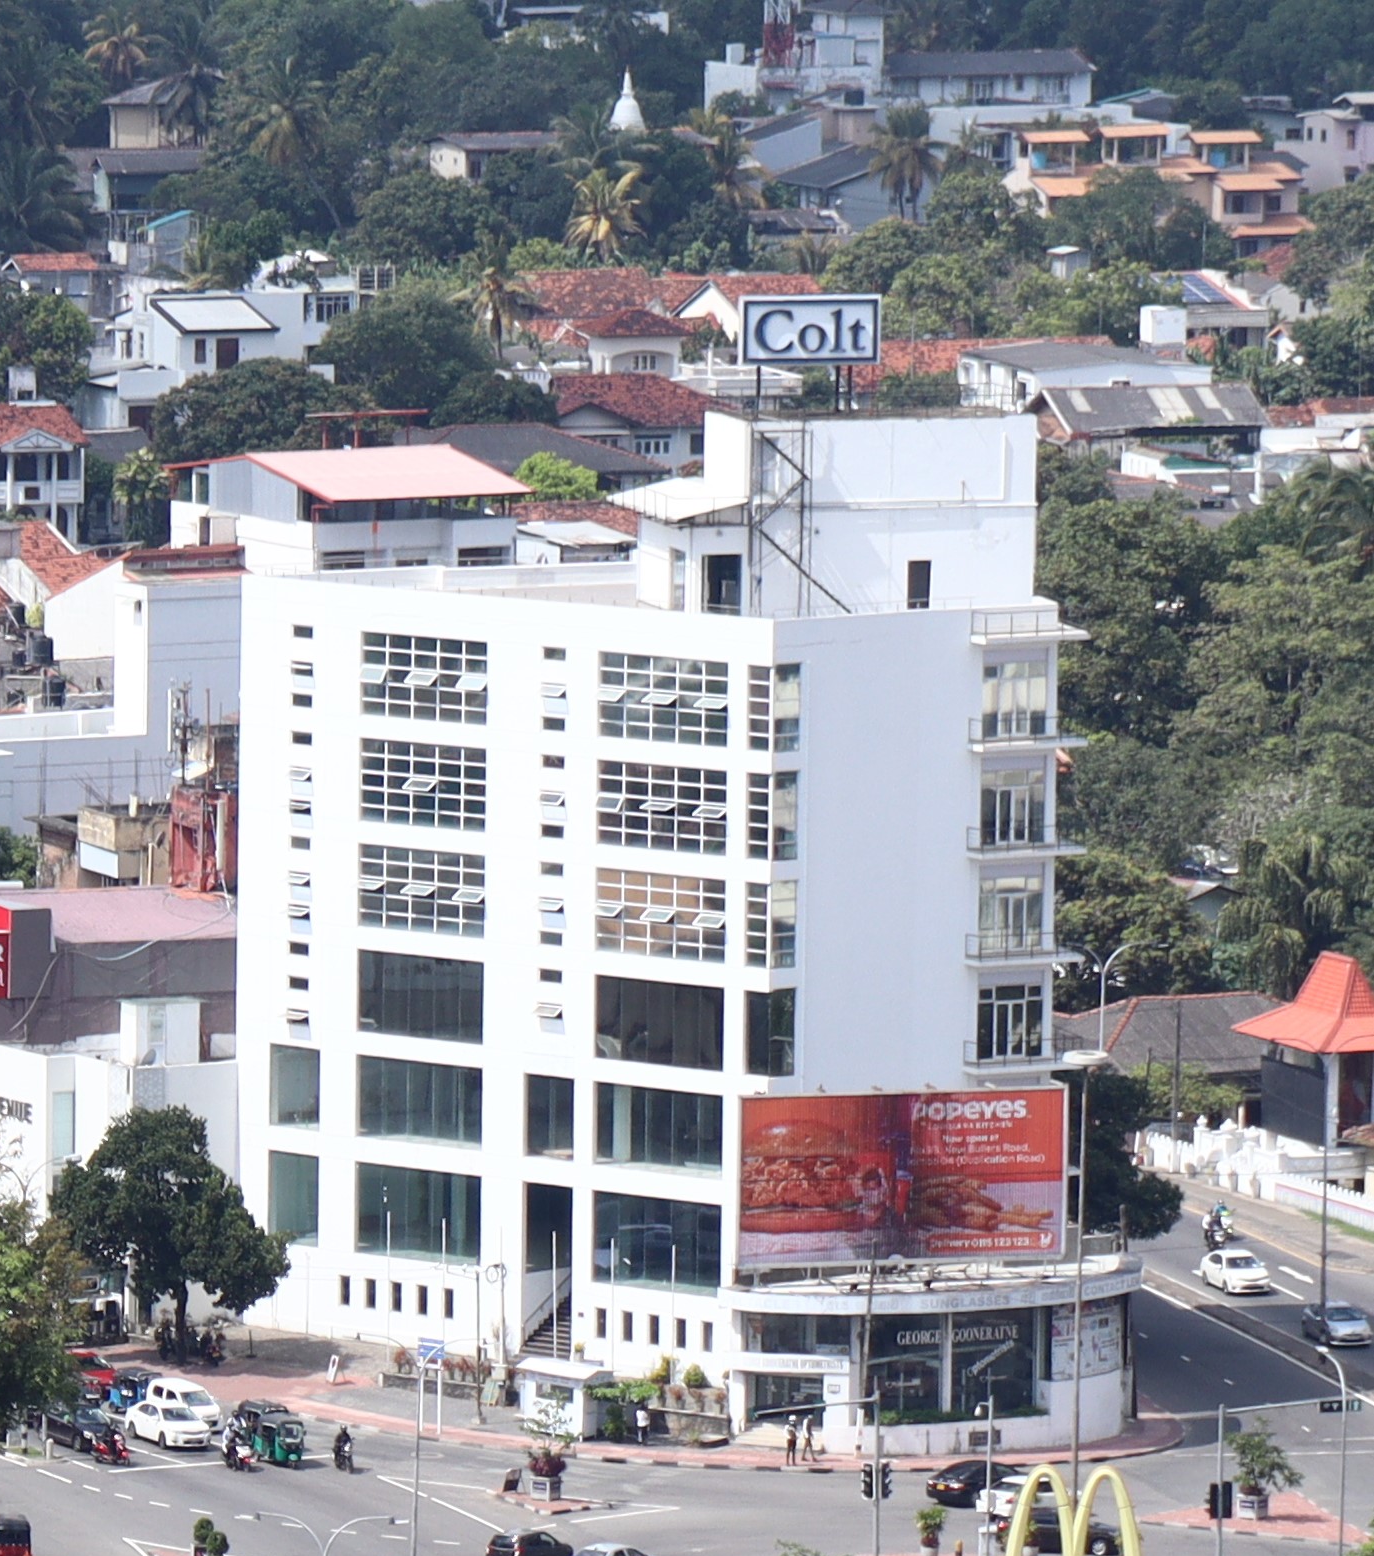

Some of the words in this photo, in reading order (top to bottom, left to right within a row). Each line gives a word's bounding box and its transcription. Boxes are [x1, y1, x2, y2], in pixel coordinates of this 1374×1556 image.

[754, 308, 866, 353] Colt
[920, 1295, 1010, 1310] SUNGLASSES
[897, 1330, 942, 1345] GEORGE
[952, 1325, 1019, 1343] GOONERATNE
